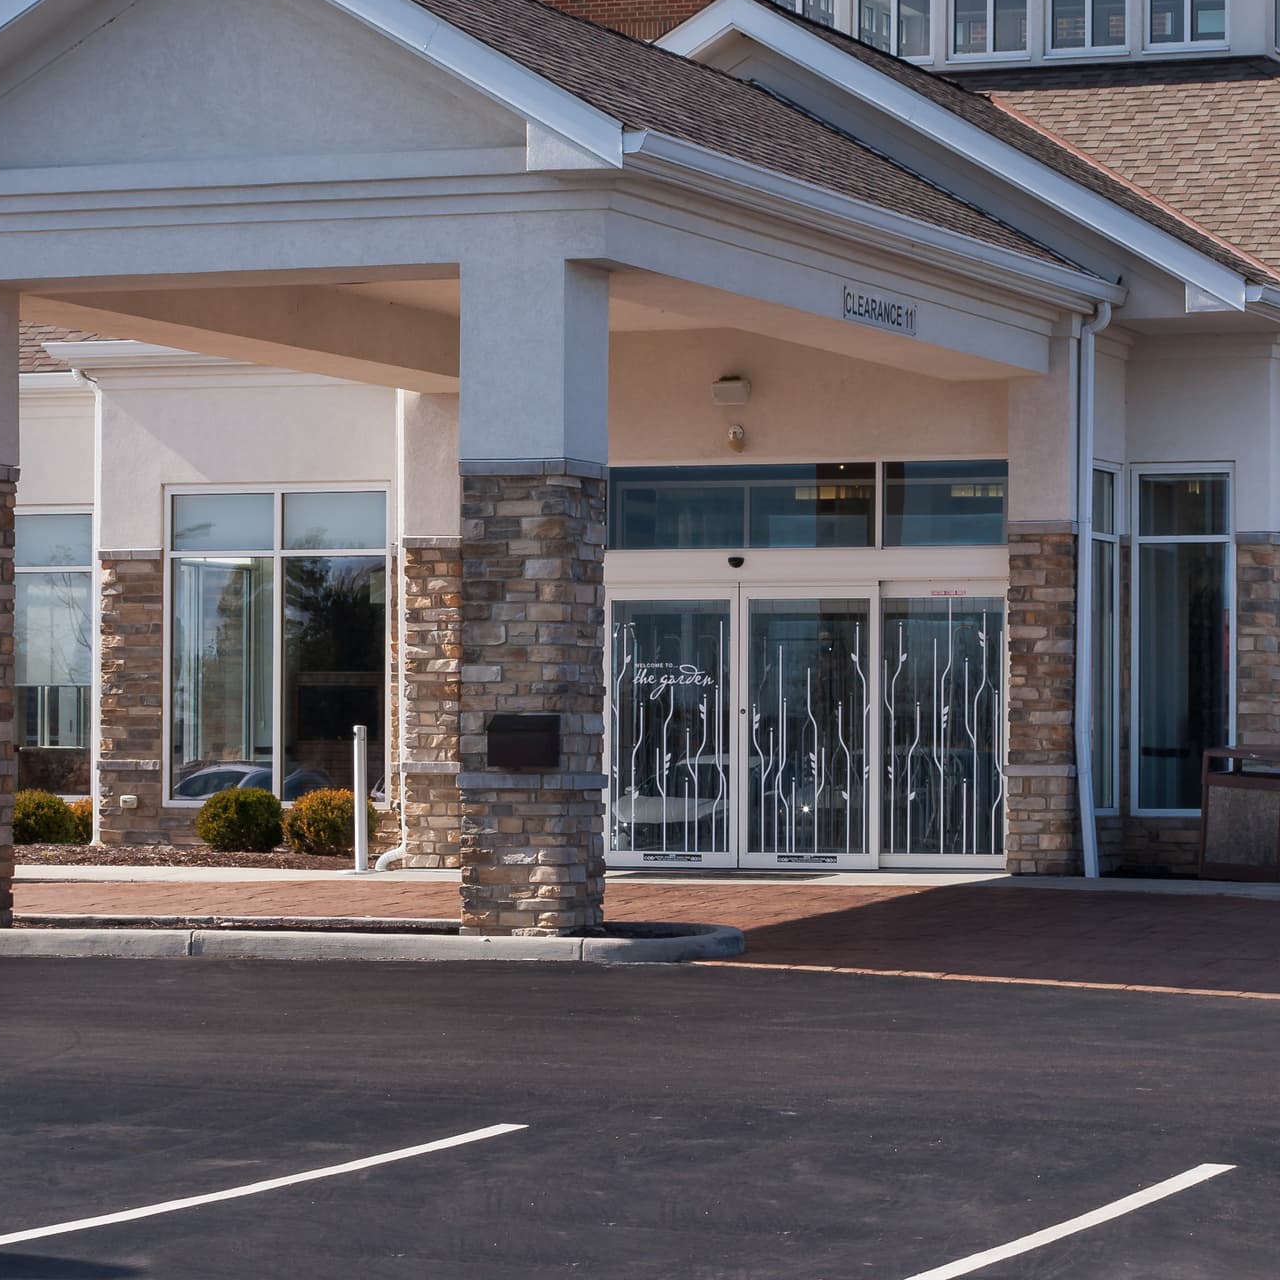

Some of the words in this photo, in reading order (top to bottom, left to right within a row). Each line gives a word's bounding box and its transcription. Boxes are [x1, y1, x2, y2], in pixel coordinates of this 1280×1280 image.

[845, 291, 902, 327] CLEARANCE
[632, 668, 657, 685] the
[649, 664, 714, 700] garden
